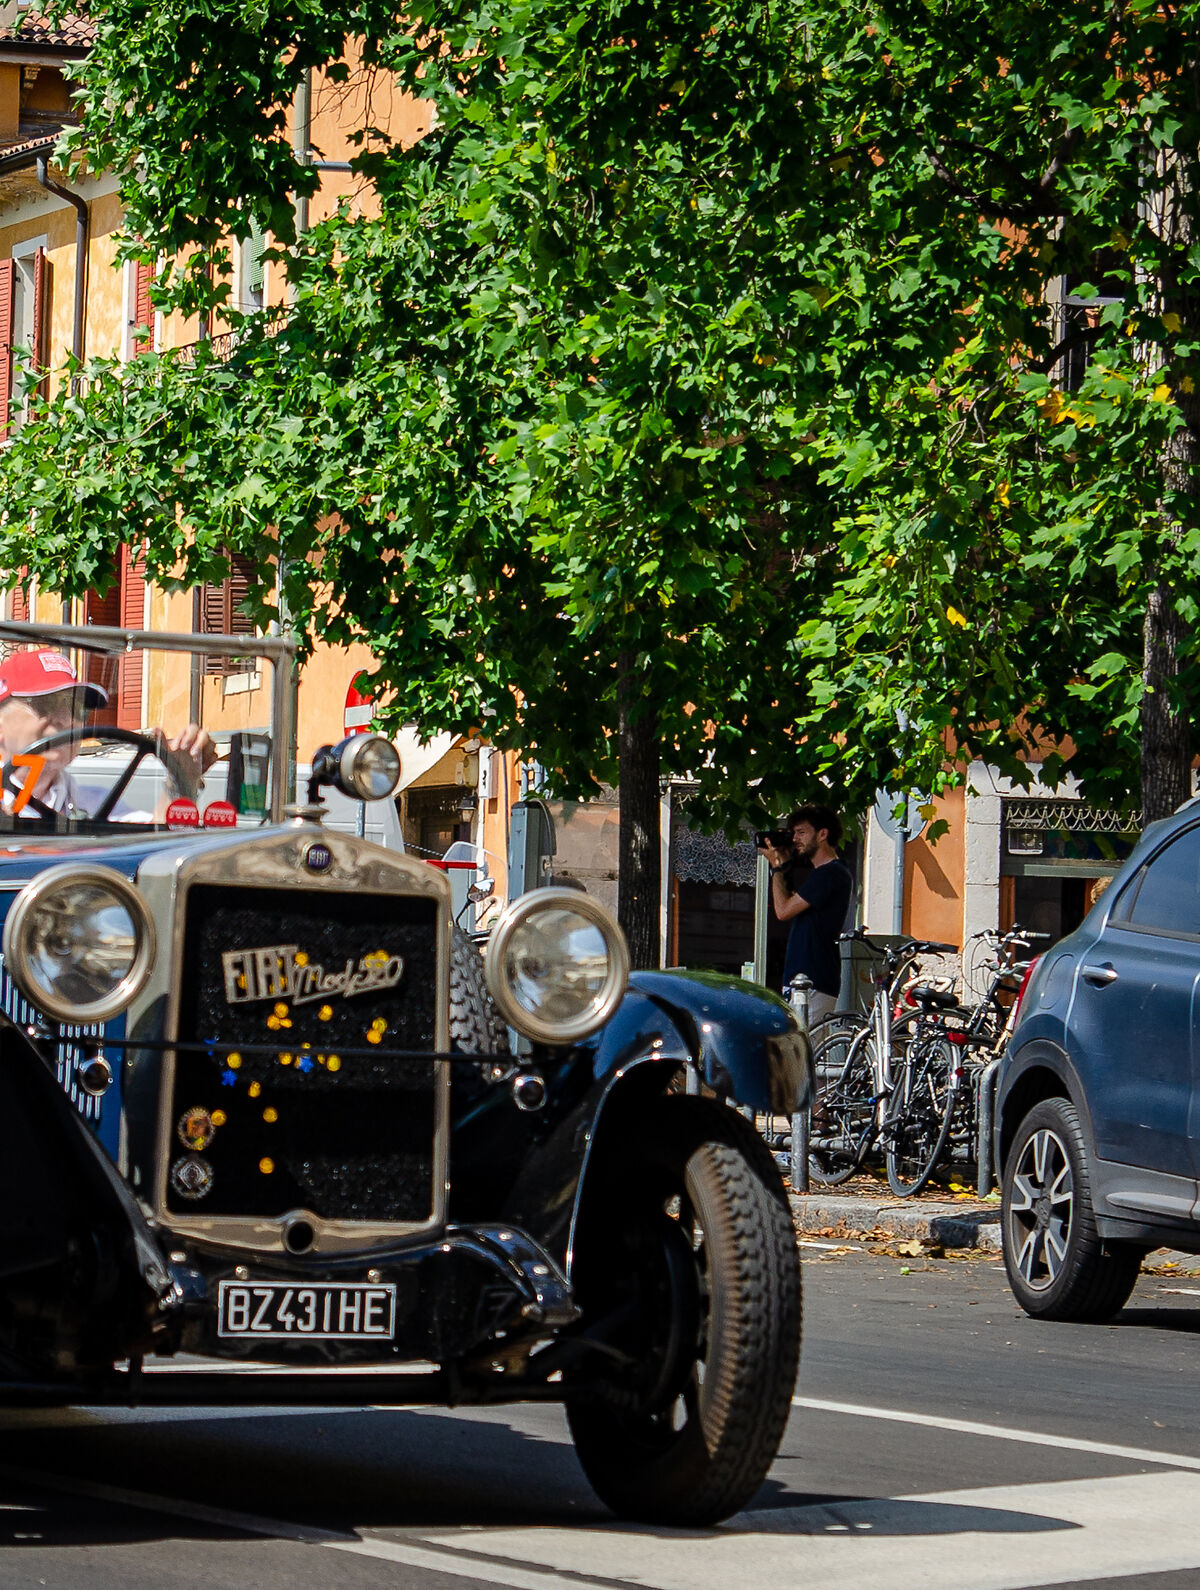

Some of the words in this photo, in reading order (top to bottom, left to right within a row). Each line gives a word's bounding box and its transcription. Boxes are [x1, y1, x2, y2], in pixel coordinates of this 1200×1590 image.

[308, 849, 329, 865] FIAT
[222, 944, 299, 1003] FIAT
[227, 1288, 387, 1333] BZ431HE
